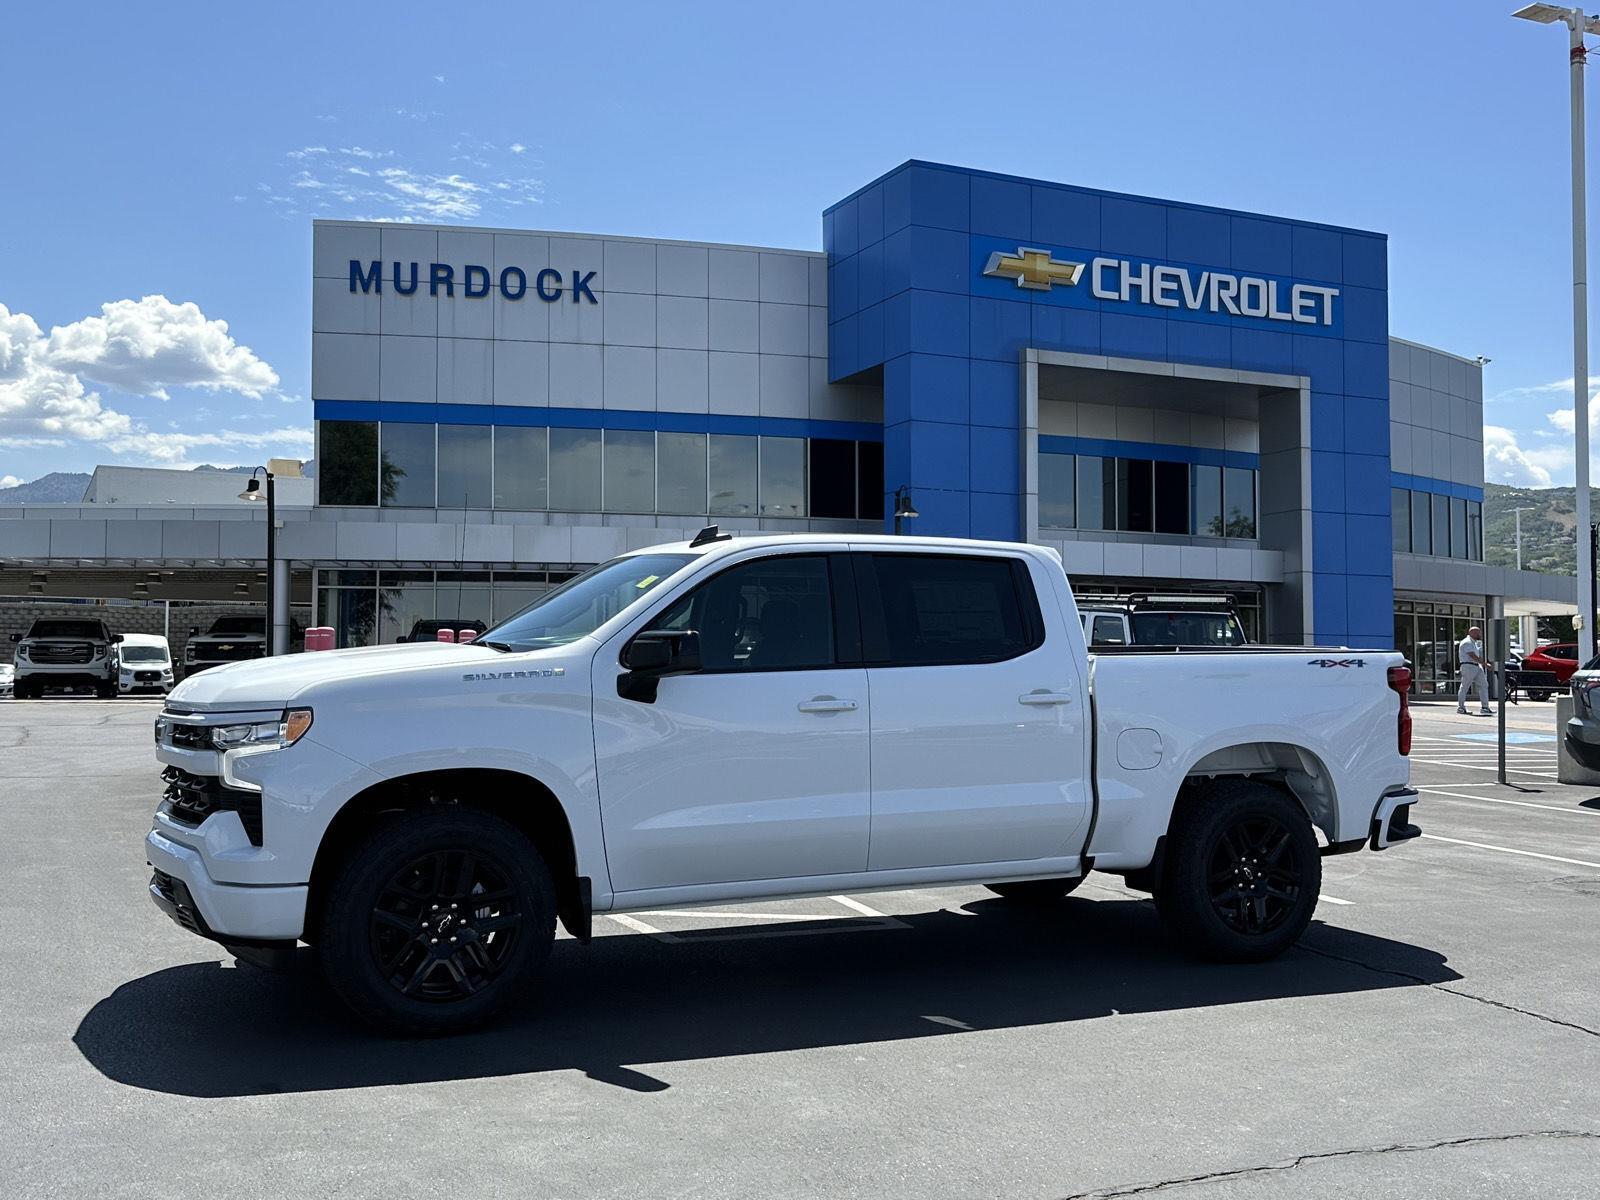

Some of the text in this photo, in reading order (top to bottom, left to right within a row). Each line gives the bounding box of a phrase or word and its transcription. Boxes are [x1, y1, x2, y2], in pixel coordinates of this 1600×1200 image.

[349, 259, 599, 305] MURDOCK
[1091, 256, 1340, 326] CHEVROLET
[462, 668, 565, 681] SILVERADO
